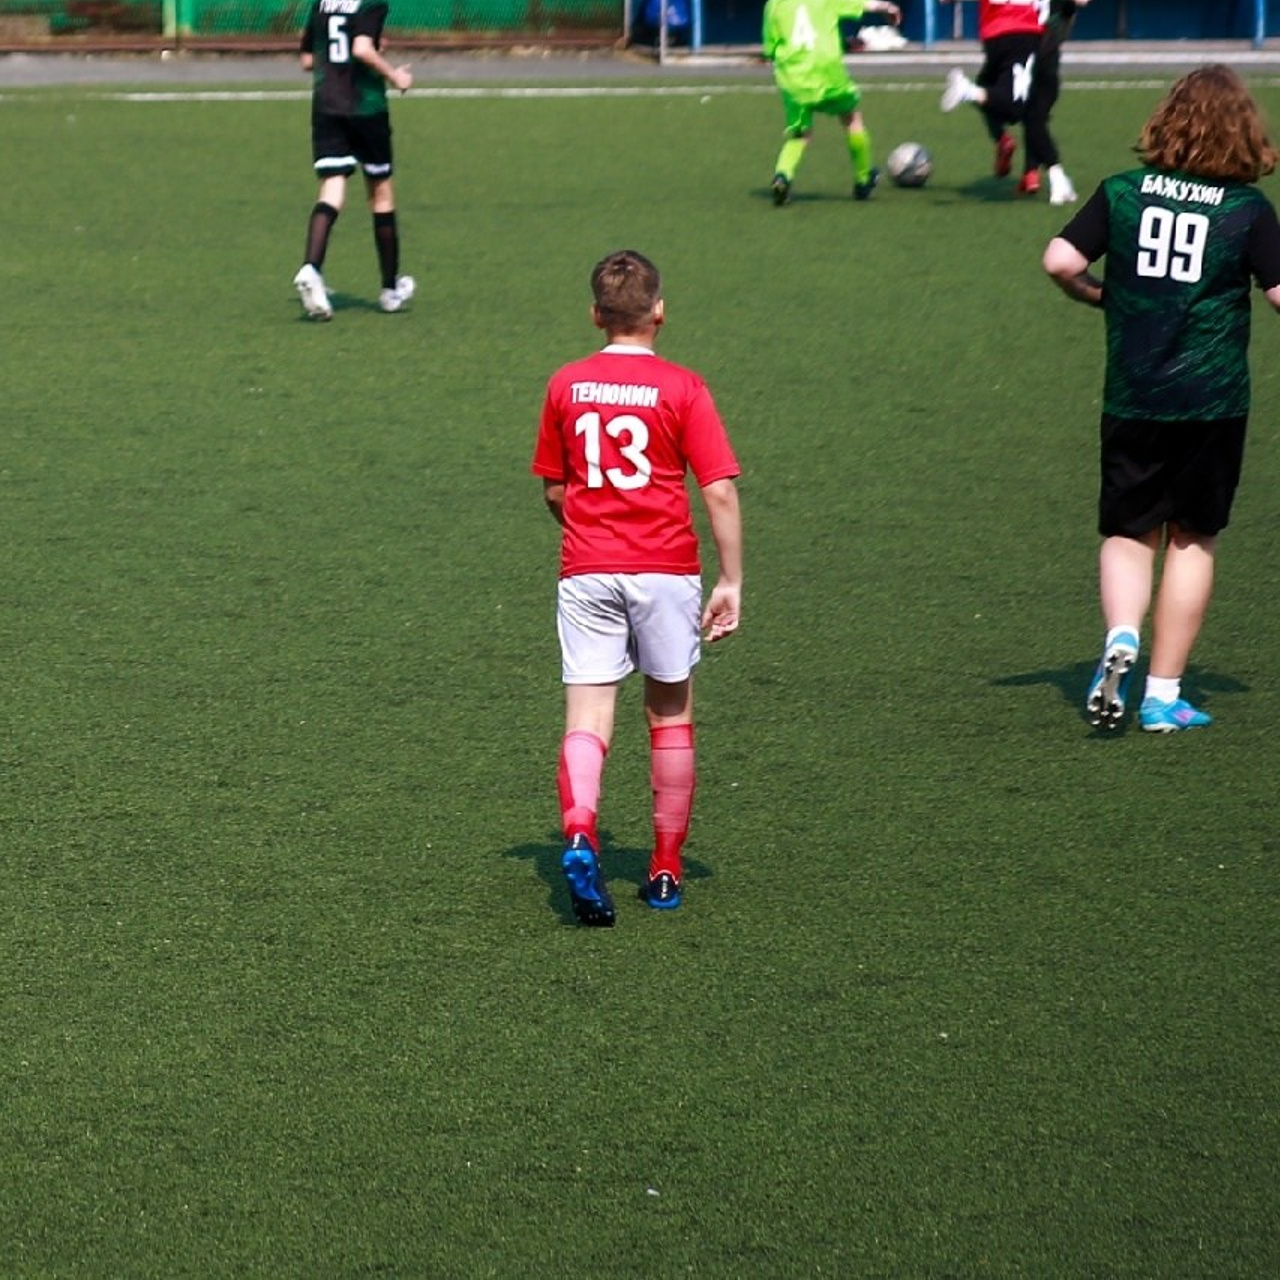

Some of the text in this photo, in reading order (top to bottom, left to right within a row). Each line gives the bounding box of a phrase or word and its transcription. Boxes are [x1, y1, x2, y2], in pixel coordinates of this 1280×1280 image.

[328, 15, 349, 63] 5
[791, 4, 819, 51] 4
[1140, 174, 1225, 206] БАЖУХИН
[1136, 205, 1210, 284] 99
[575, 411, 652, 491] 13
